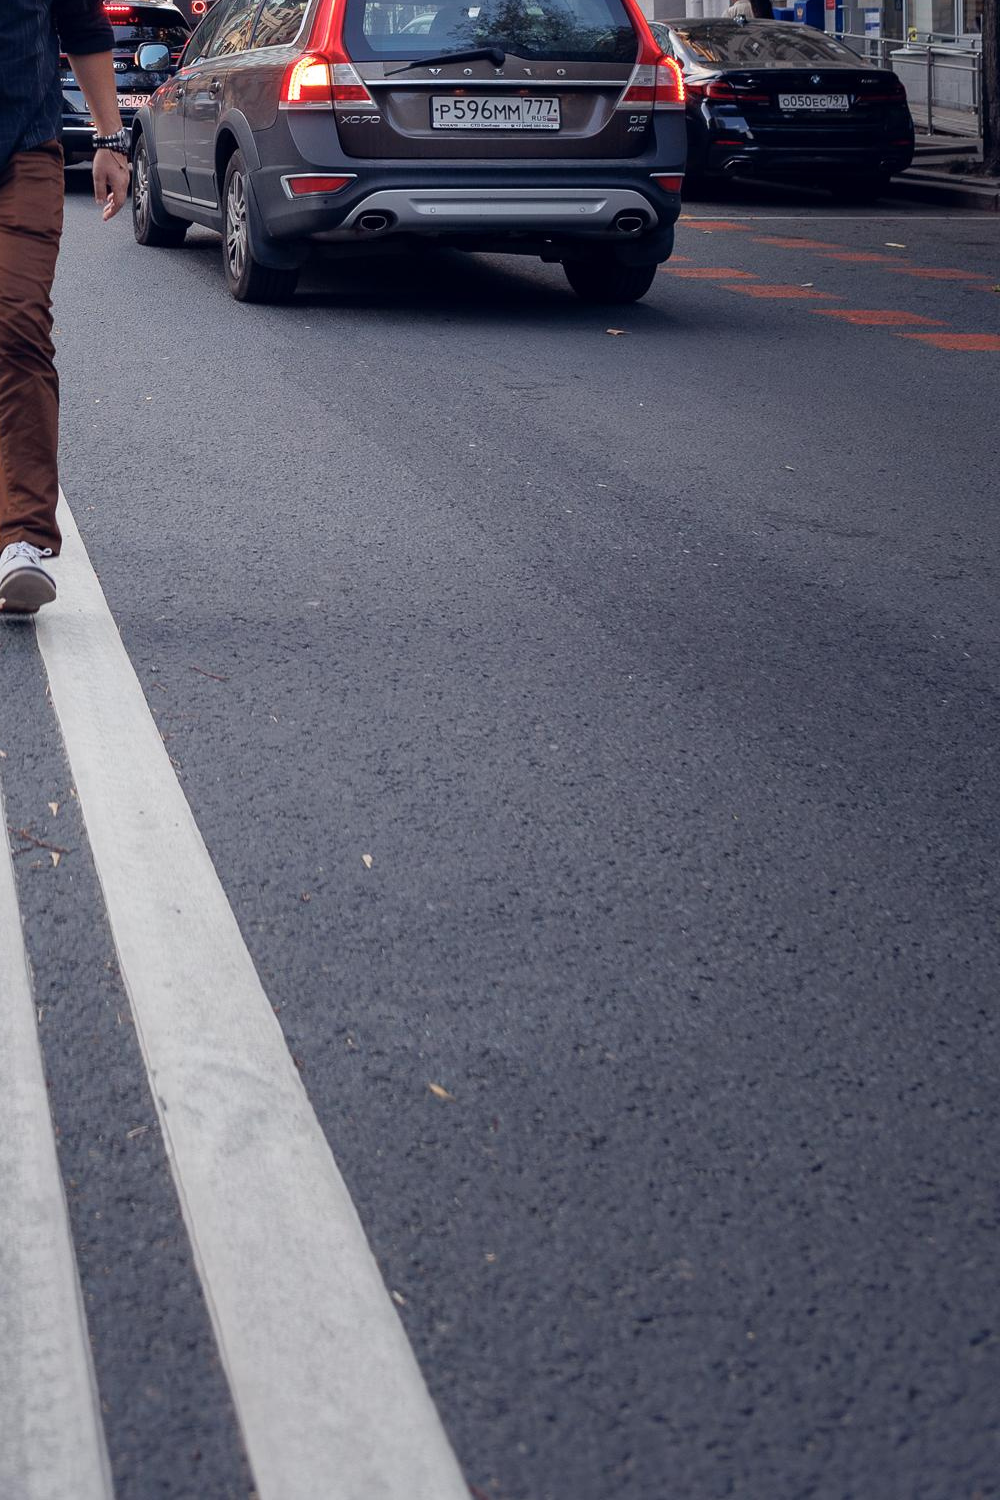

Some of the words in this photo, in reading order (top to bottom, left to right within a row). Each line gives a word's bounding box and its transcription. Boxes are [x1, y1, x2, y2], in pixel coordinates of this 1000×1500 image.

[429, 68, 566, 76] VOLVO
[524, 100, 554, 115] 777
[340, 115, 381, 124] XC70
[630, 115, 648, 124] D5
